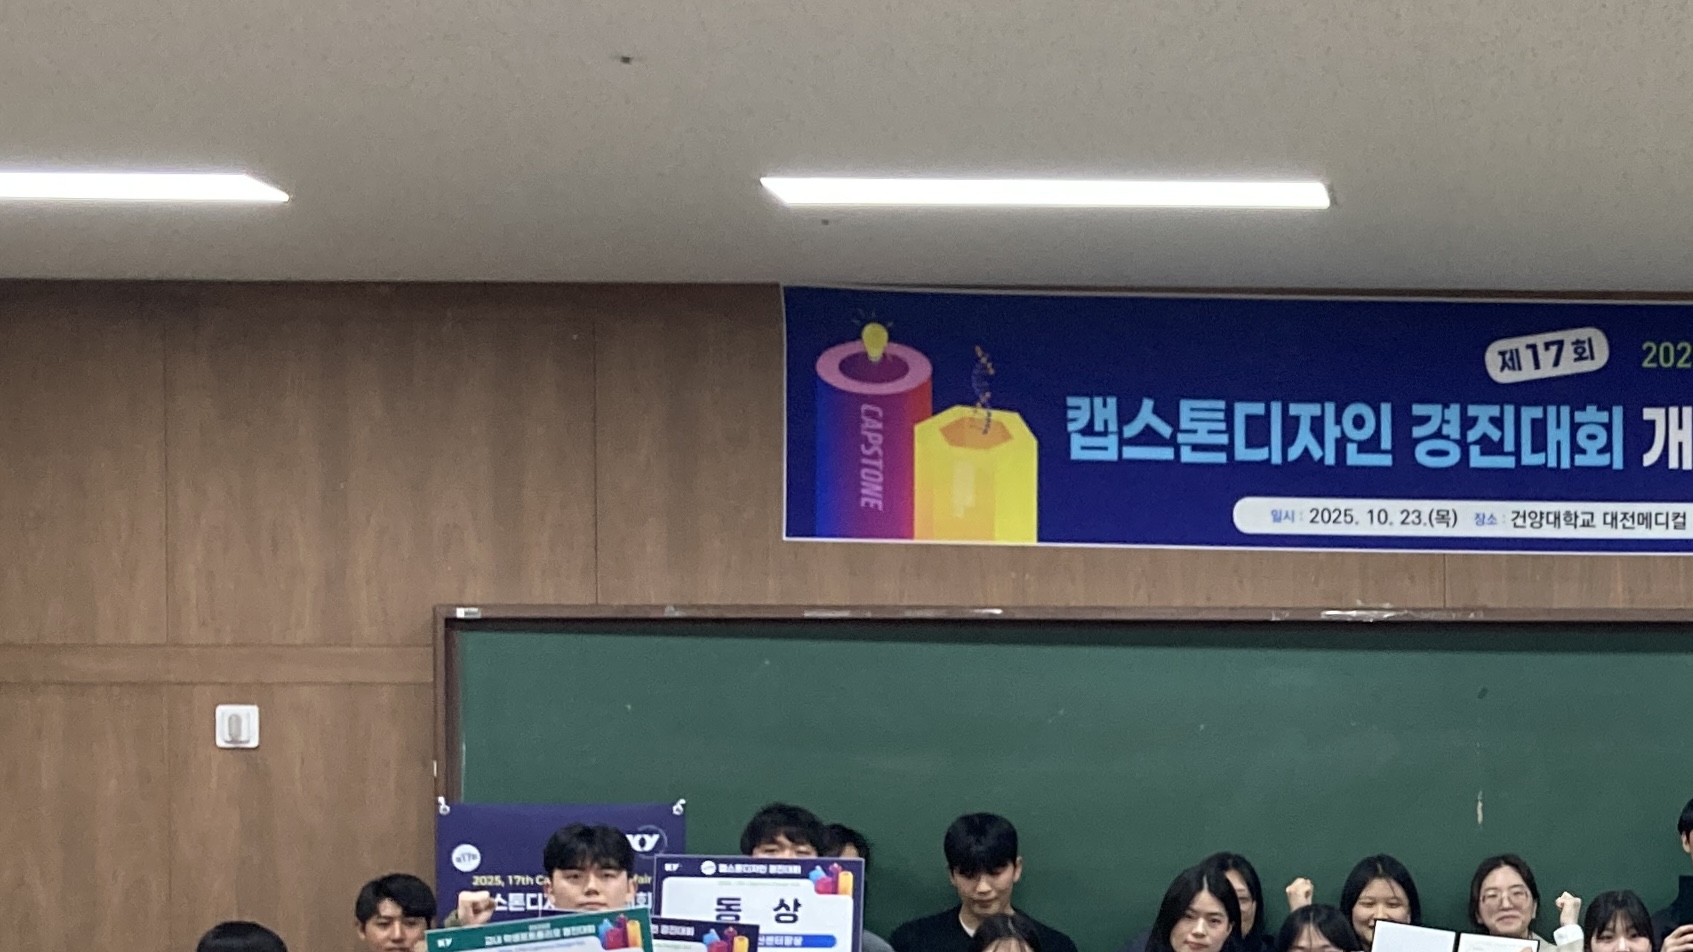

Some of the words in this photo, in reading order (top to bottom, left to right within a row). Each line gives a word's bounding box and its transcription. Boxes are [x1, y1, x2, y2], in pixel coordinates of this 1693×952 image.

[1496, 335, 1596, 375] 제17회
[1065, 395, 1394, 469] 캡스톤디자인
[1409, 403, 1625, 471] 경진대회
[860, 403, 884, 512] CAPSTONE
[1309, 507, 1360, 526] 2025.
[1367, 508, 1394, 526] 10.
[1511, 510, 1596, 530] 건양대학교
[1603, 510, 1687, 531] 대전메디컬
